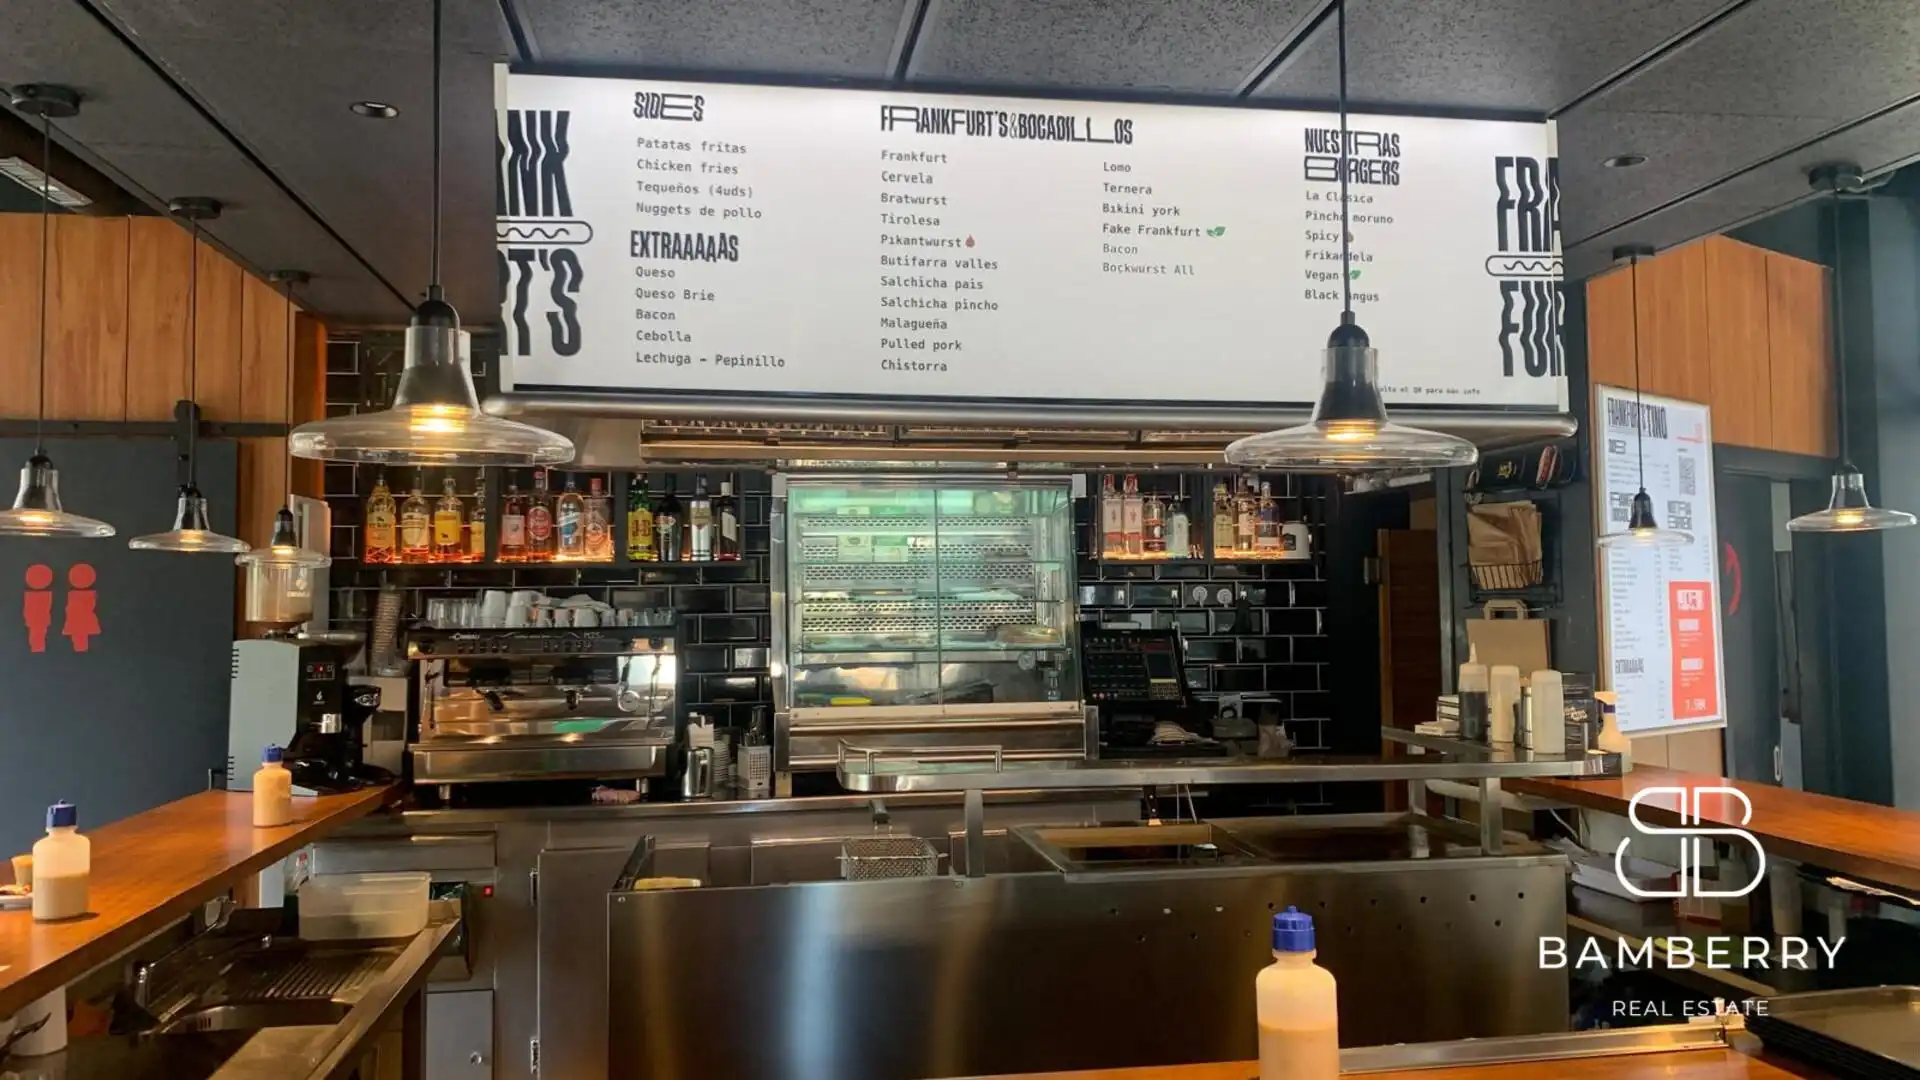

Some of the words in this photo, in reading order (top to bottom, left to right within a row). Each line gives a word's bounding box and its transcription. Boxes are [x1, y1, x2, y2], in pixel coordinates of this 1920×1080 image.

[633, 92, 705, 122] SIDES
[637, 137, 691, 152] Patatas
[701, 141, 746, 154] fritas
[881, 150, 947, 163] Frankfurt
[637, 159, 691, 172] Chicken
[701, 162, 738, 175] fries
[1104, 162, 1131, 172] Lomo
[881, 171, 933, 184] Cervela
[637, 181, 699, 194] Tequeños
[709, 185, 752, 198] (4uds)
[1104, 183, 1152, 195] Ternera
[881, 192, 946, 205] Bratwurst
[1306, 191, 1320, 200] La
[1326, 191, 1374, 204] Clsica
[636, 202, 691, 216] Nuggets
[700, 206, 715, 216] de
[724, 207, 762, 219] pollo
[1103, 203, 1144, 214] Bikini
[1152, 206, 1179, 217] york
[880, 213, 940, 226] Tirolesa
[1352, 214, 1394, 223] moruno
[1103, 223, 1130, 234] Fake
[1138, 225, 1200, 236] Frankfurt
[1305, 230, 1339, 242] Spicy
[631, 230, 738, 263] EXTRAAAAAS
[881, 234, 961, 247] Pikantwurst
[1103, 243, 1138, 256] Bacon
[881, 255, 947, 267] Butifarra
[635, 266, 675, 278] Queso
[1103, 262, 1166, 274] Bockwurst
[881, 276, 947, 288] Salchicha
[1304, 270, 1340, 281] Vegan
[635, 288, 676, 299] Queso
[684, 289, 714, 301] Brie
[1304, 289, 1340, 300] Black
[881, 297, 947, 309] Salchicha
[955, 299, 998, 312] pincho
[636, 309, 675, 320] Bacon
[881, 318, 947, 331] Malagueña
[636, 330, 691, 342] Cebolla
[881, 338, 925, 349] Pulled
[933, 340, 961, 352] pork
[636, 352, 691, 366] Lechuga
[715, 354, 785, 368] Pepinillo
[881, 358, 947, 371] Chistorra
